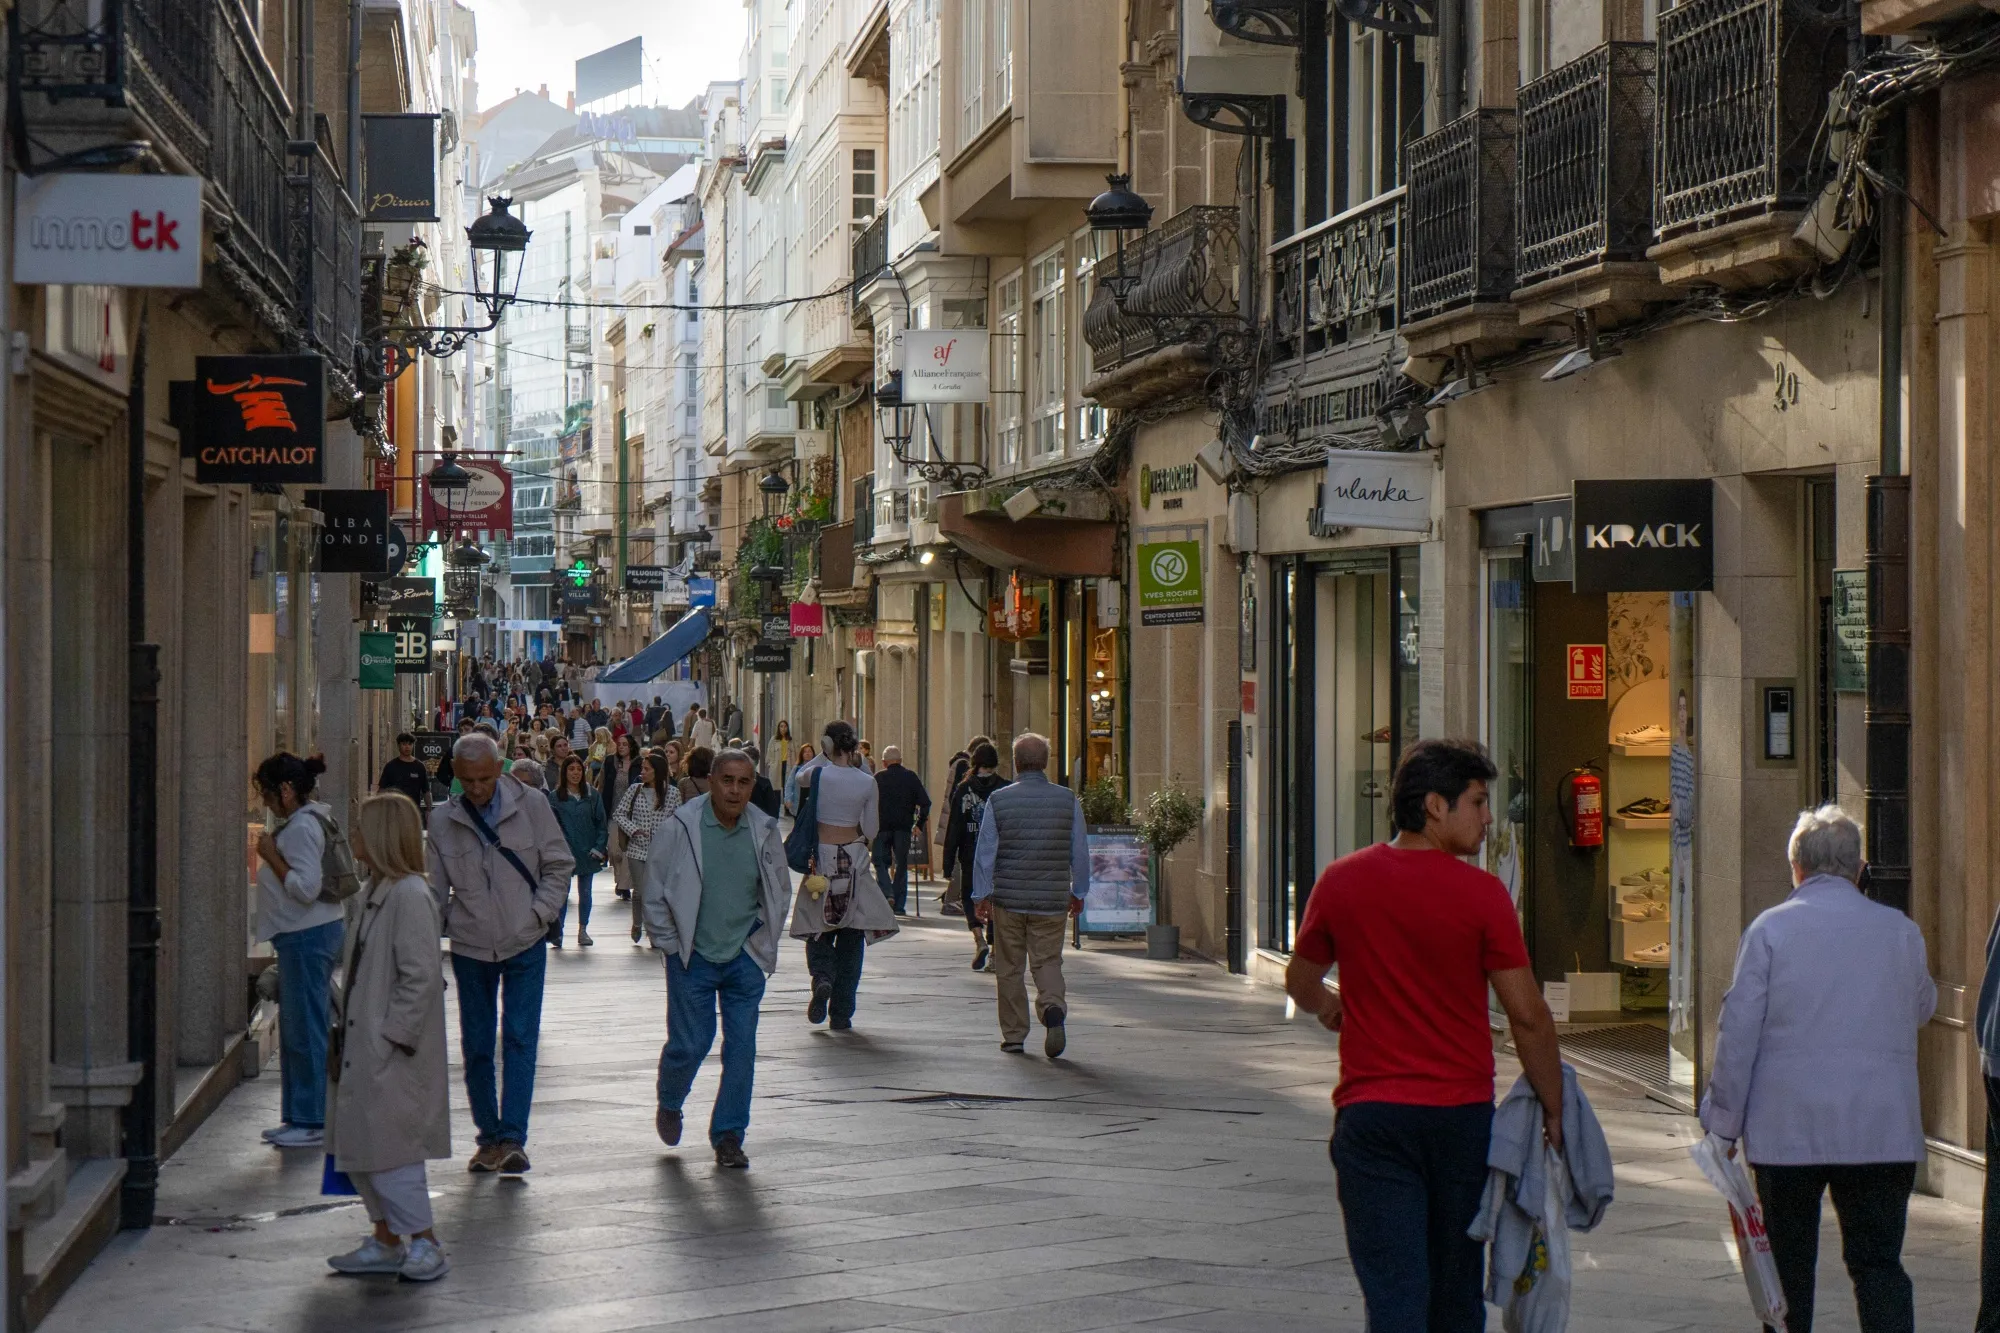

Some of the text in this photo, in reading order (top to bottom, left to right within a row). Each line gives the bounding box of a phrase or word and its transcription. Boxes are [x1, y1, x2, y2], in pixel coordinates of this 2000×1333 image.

[201, 447, 316, 465] CATCHALOT
[1335, 477, 1424, 501] ulanka
[1586, 523, 1700, 548] KRACK
[1166, 589, 1198, 598] ROCHER
[1144, 612, 1166, 620] CENTRO
[793, 624, 821, 633] joya36
[1571, 685, 1602, 694] EXTINTOR
[423, 745, 442, 754] ORO
